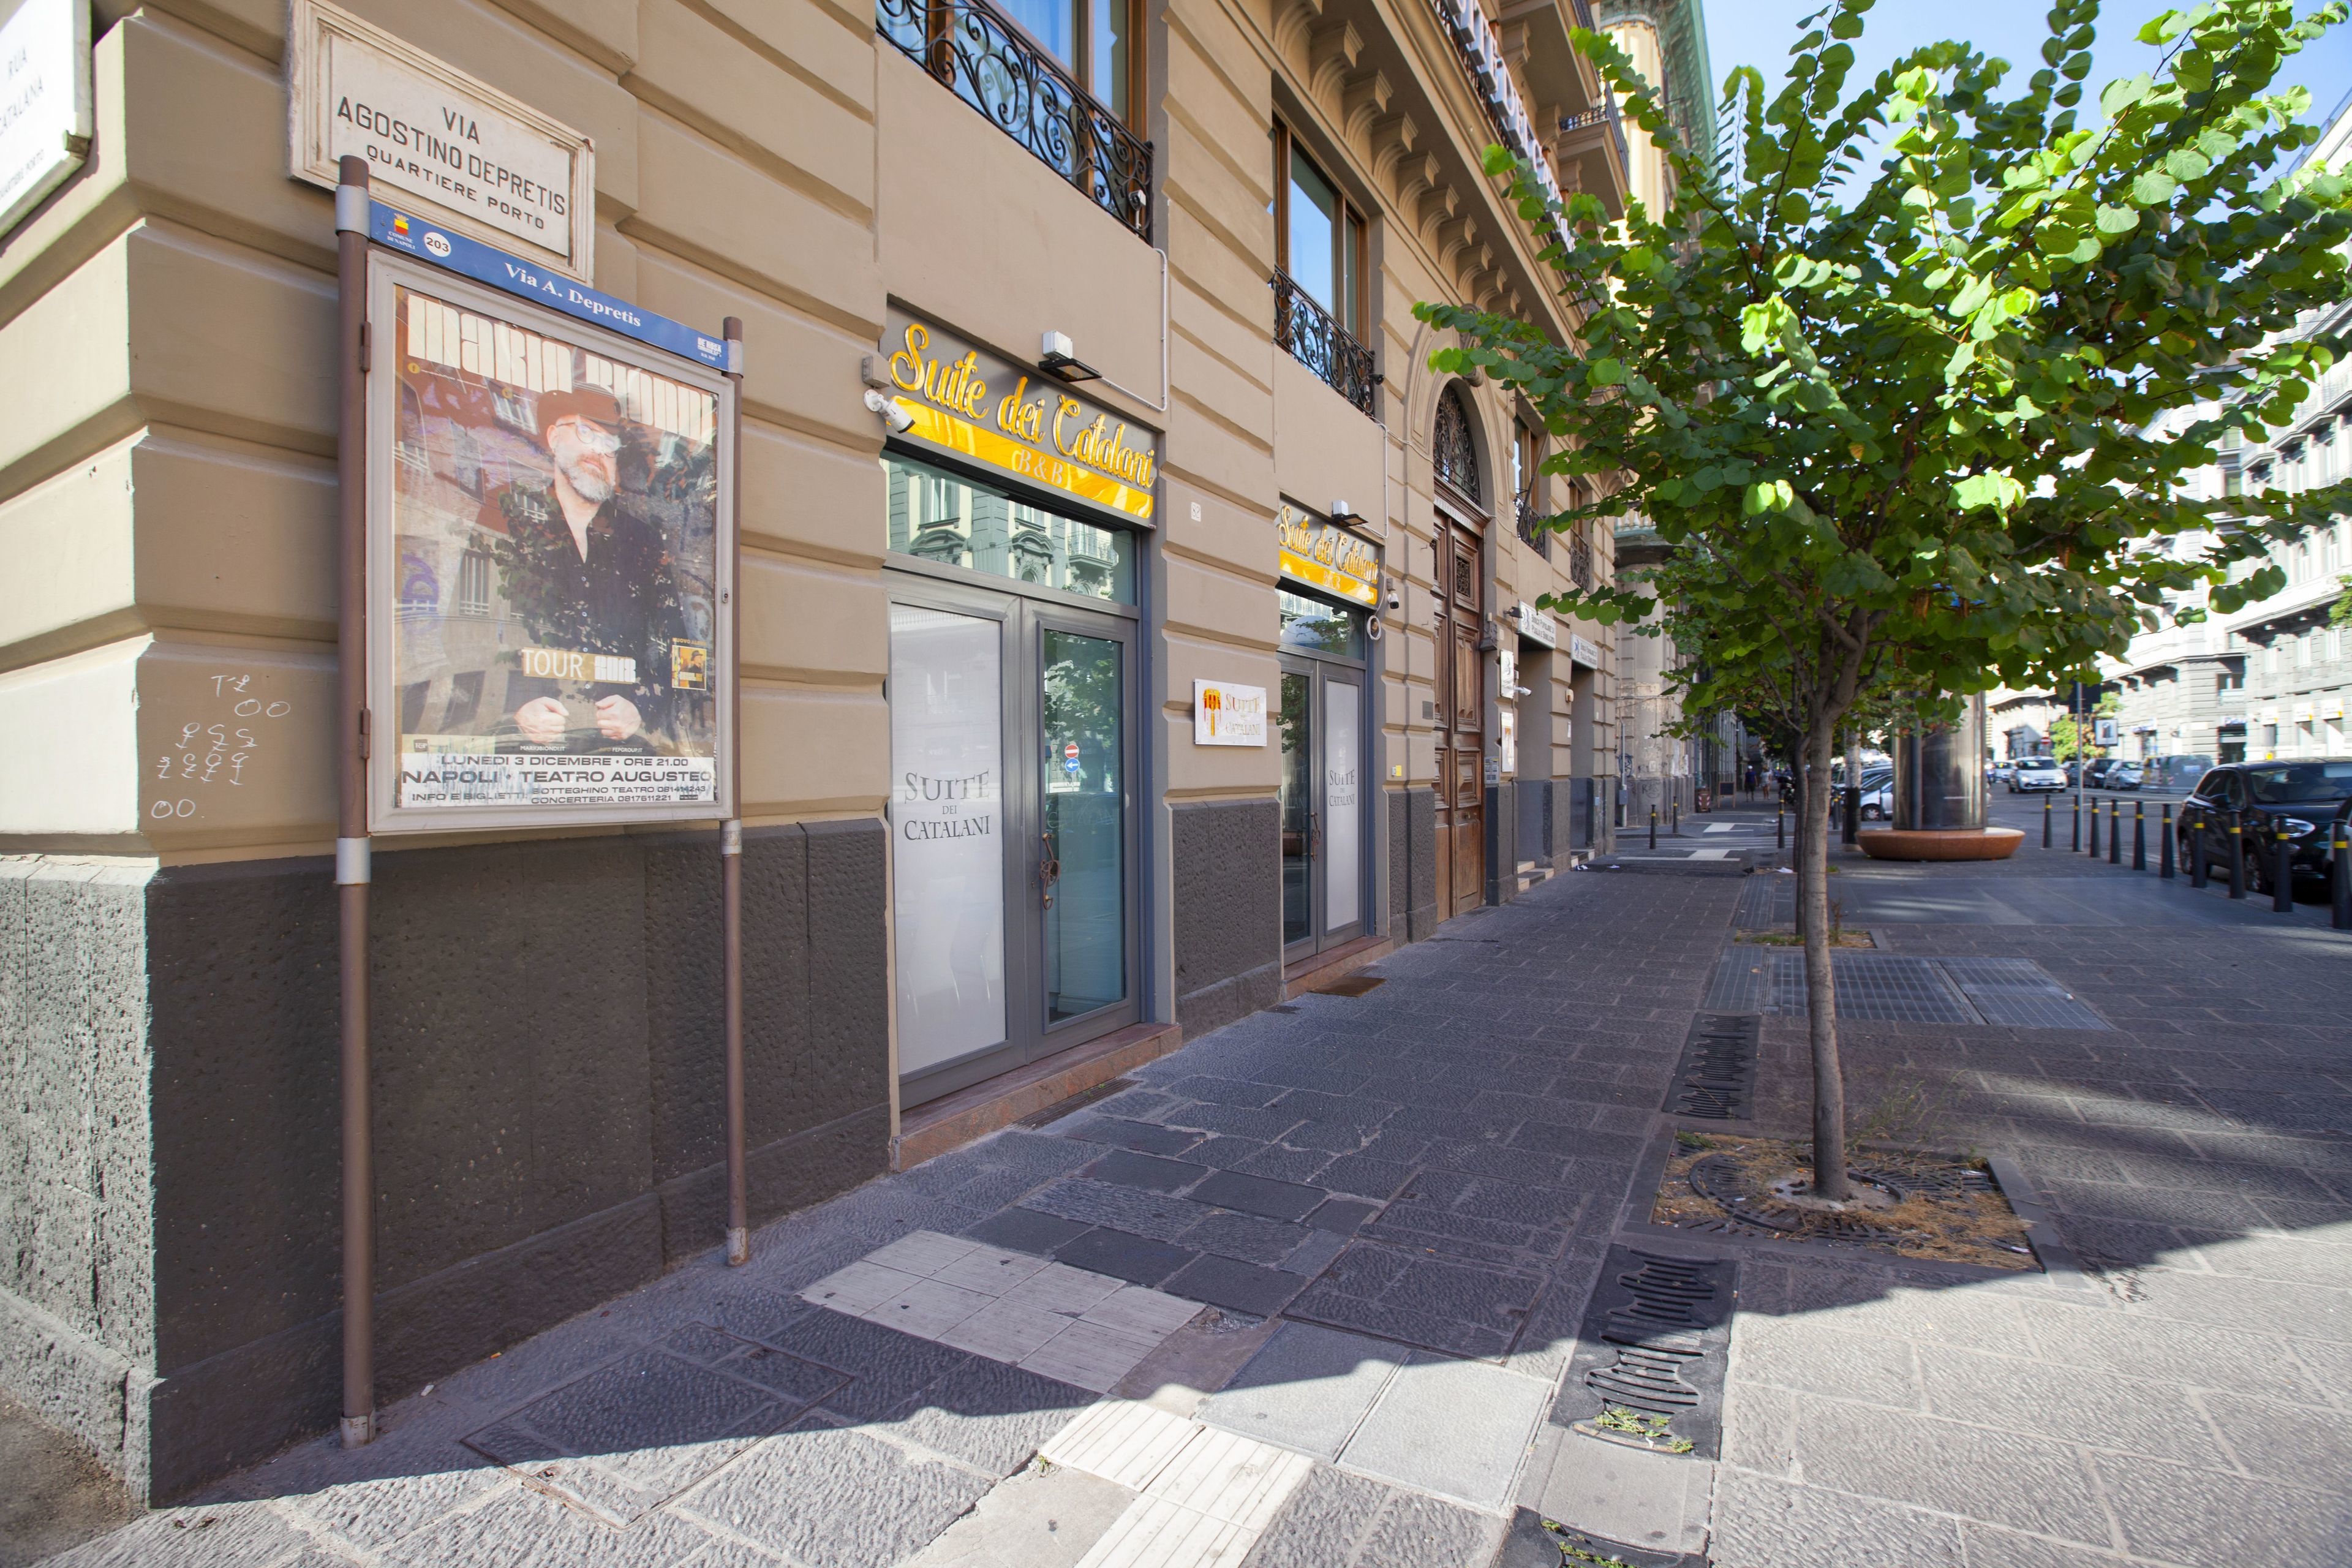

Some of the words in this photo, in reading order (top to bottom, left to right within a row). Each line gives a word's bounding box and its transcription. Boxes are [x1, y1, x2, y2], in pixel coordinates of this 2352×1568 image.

[442, 107, 480, 145] VIA
[337, 97, 462, 170] AGOSTINO
[469, 154, 565, 216] DEPRETIS
[367, 145, 477, 202] QUARTIERE
[488, 197, 545, 230] PORTO
[388, 231, 413, 243] COMUNE
[394, 238, 416, 250] NAPOLI
[426, 236, 450, 252] 203
[504, 262, 538, 288] Via
[542, 281, 564, 298] A.
[568, 288, 642, 328] Depretis
[888, 323, 989, 420] Suite
[997, 376, 1046, 444] dei
[1052, 394, 1156, 489] Catalani
[1278, 505, 1312, 557] Suite
[1314, 524, 1334, 567] dei
[1335, 532, 1379, 585] Catalani
[522, 649, 583, 678] TOUR
[514, 756, 524, 766] 3
[530, 757, 611, 766] DICEMBRE
[624, 758, 653, 766] ORE
[402, 771, 498, 784] NAPOLI
[519, 771, 605, 783] TEATRO
[611, 771, 712, 782] AUGUSTEO
[905, 768, 990, 804] SUITE
[1329, 769, 1355, 786] SUITE
[531, 795, 614, 804] CONCERTERIA
[942, 805, 957, 815] DEI
[1329, 794, 1355, 807] CATALANI
[905, 815, 990, 841] CATALANI
